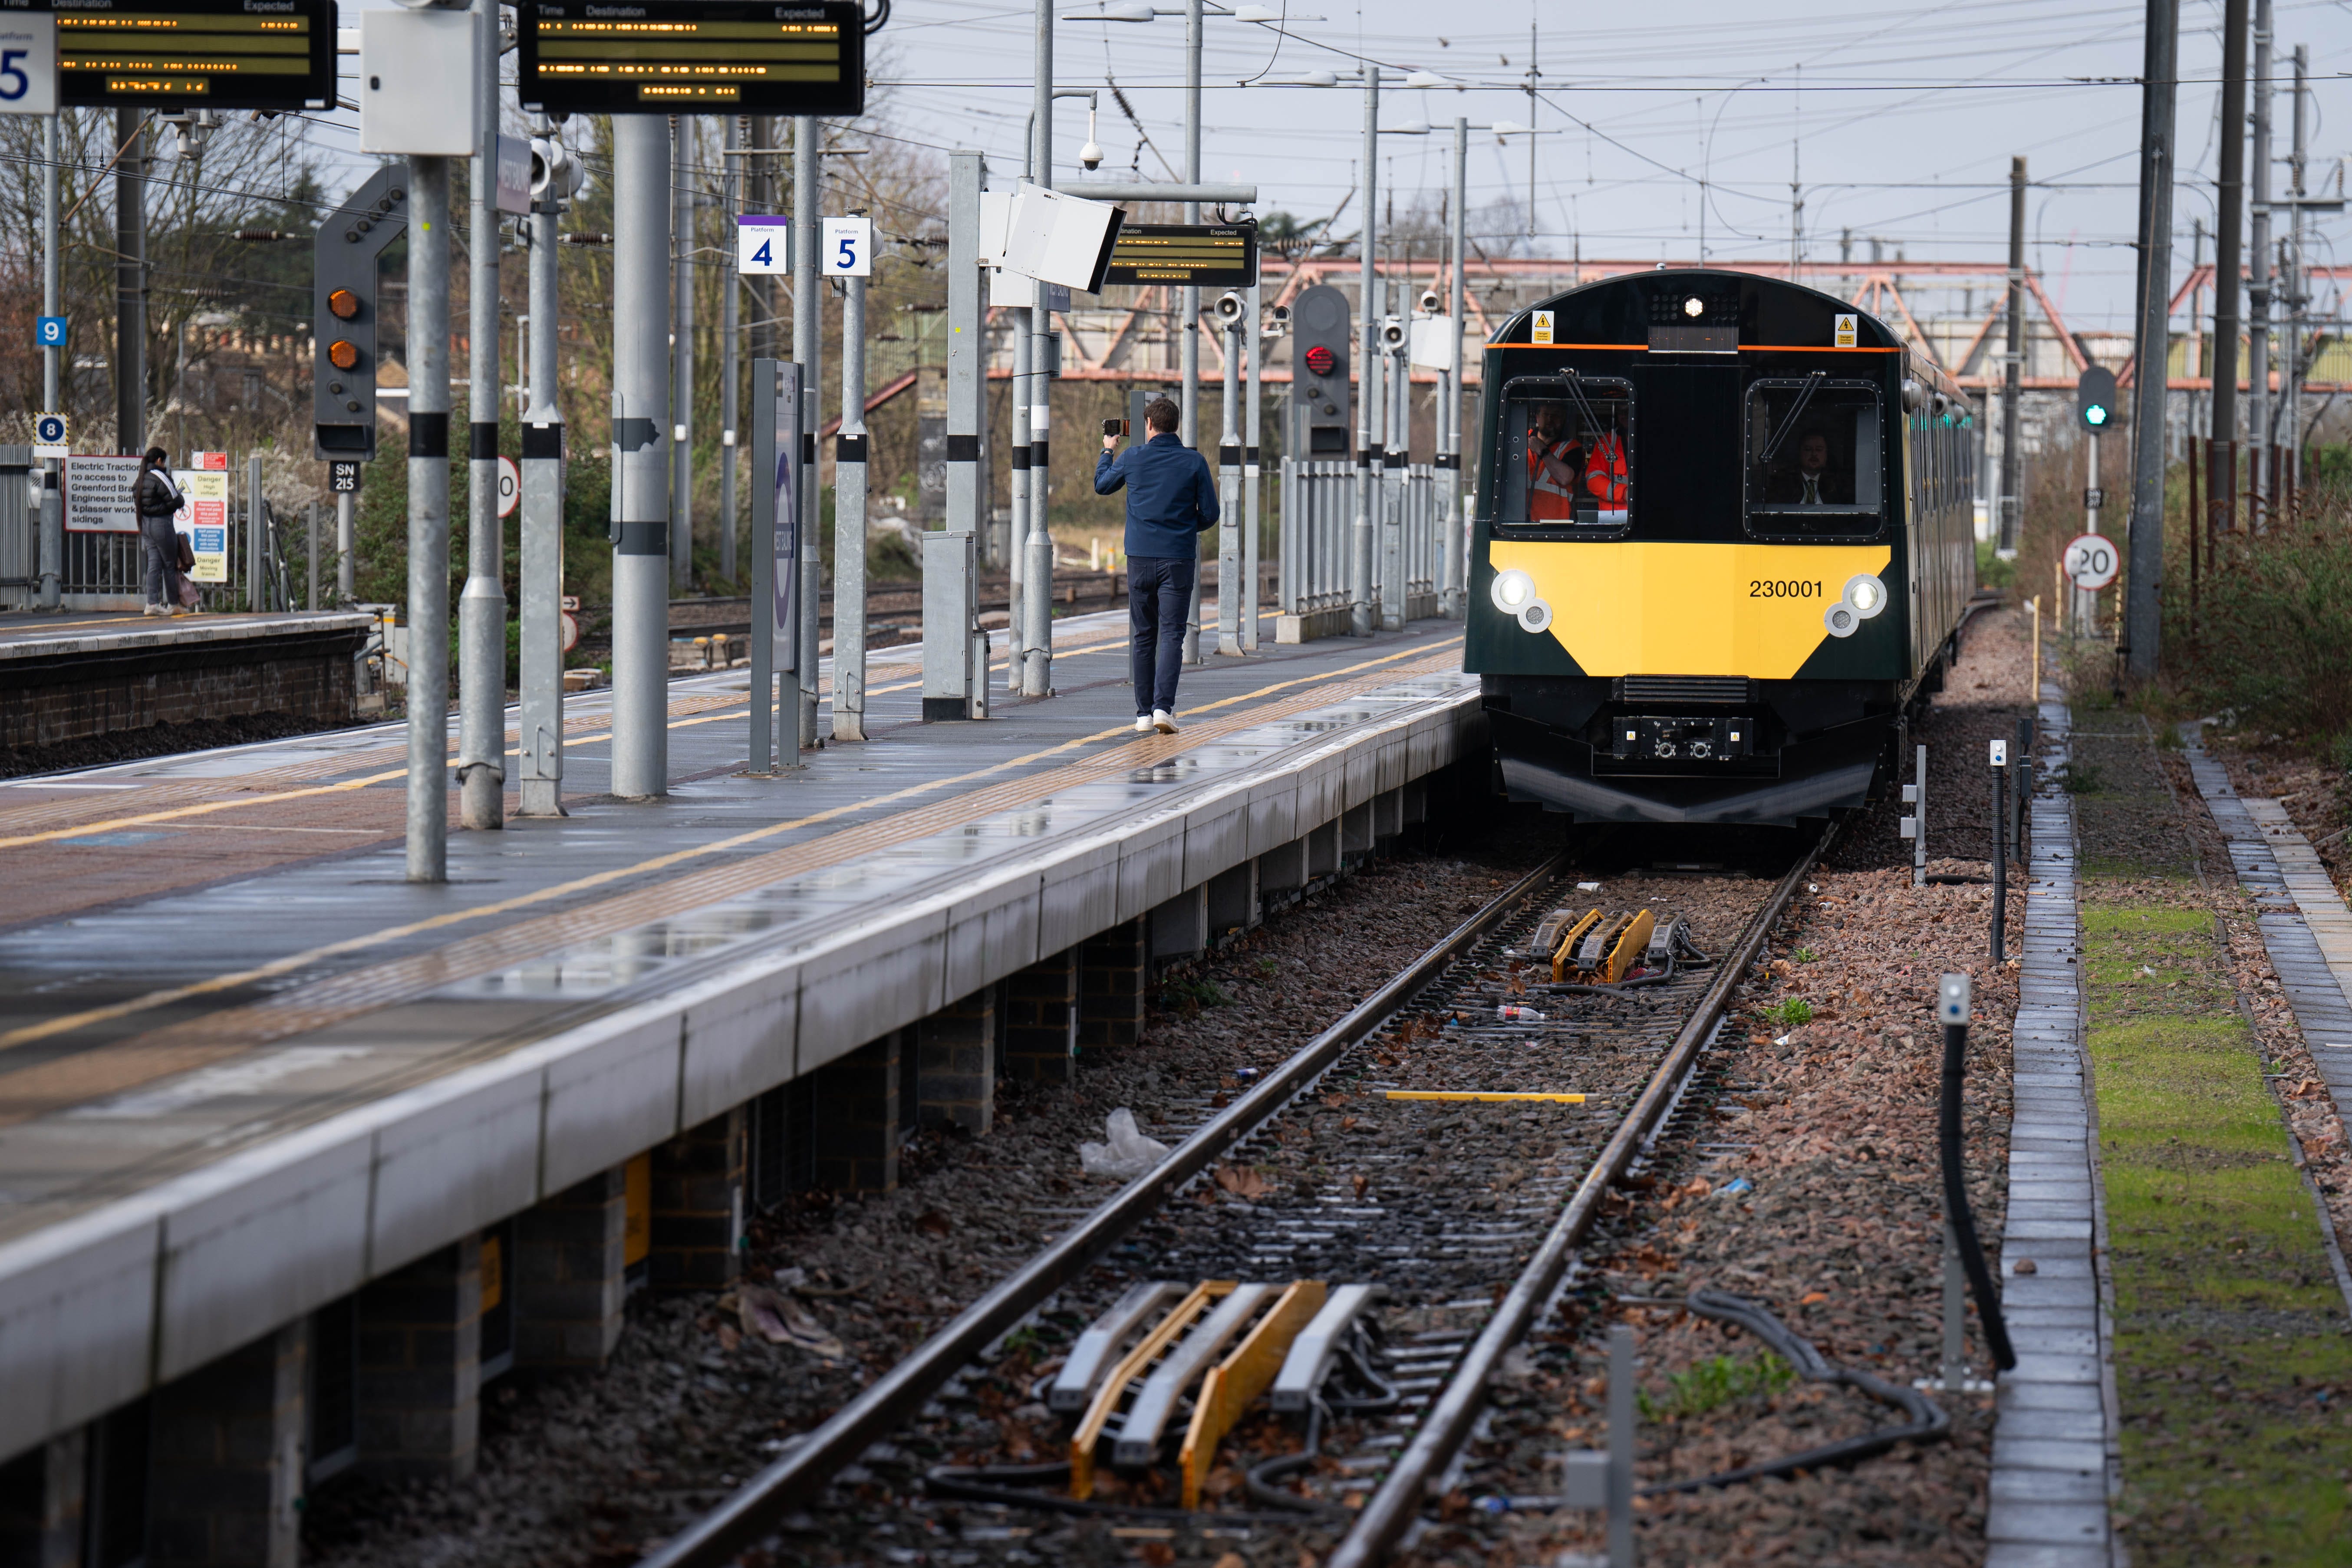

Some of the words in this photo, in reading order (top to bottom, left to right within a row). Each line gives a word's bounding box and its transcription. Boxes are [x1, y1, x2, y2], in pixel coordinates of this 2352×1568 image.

[244, 1, 295, 12] Expected
[538, 4, 564, 16] Time
[586, 5, 646, 17] Destination
[775, 7, 825, 20] Expected
[0, 32, 33, 41] atform
[0, 49, 29, 101] 5
[750, 237, 772, 266] 4
[837, 239, 856, 269] 5
[44, 322, 59, 341] 9
[46, 423, 56, 436] 8
[71, 462, 104, 470] Electric
[336, 464, 354, 476] SN
[336, 478, 354, 490] 215
[500, 476, 513, 496] 0
[71, 494, 115, 503] Engineers
[79, 505, 112, 514] plasser
[72, 516, 103, 524] sidings
[1749, 580, 1822, 598] 230001
